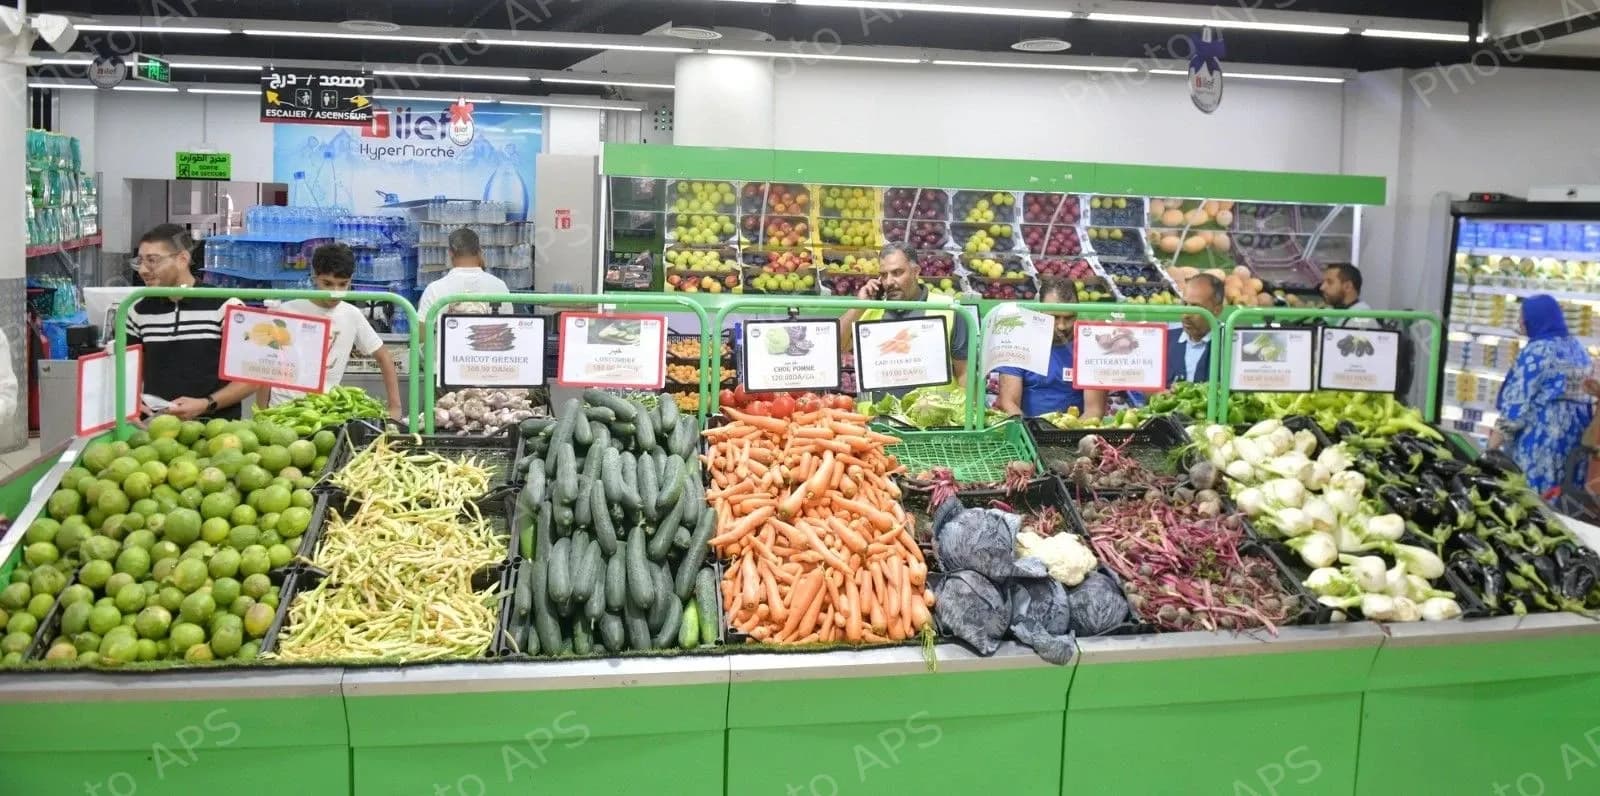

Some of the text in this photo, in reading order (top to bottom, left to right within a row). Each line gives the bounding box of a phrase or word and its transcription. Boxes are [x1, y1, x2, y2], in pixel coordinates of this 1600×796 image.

[269, 73, 297, 89] درج
[319, 75, 365, 88] مصعد
[266, 109, 306, 118] ESCALIER
[315, 111, 367, 120] ASCENSEUR
